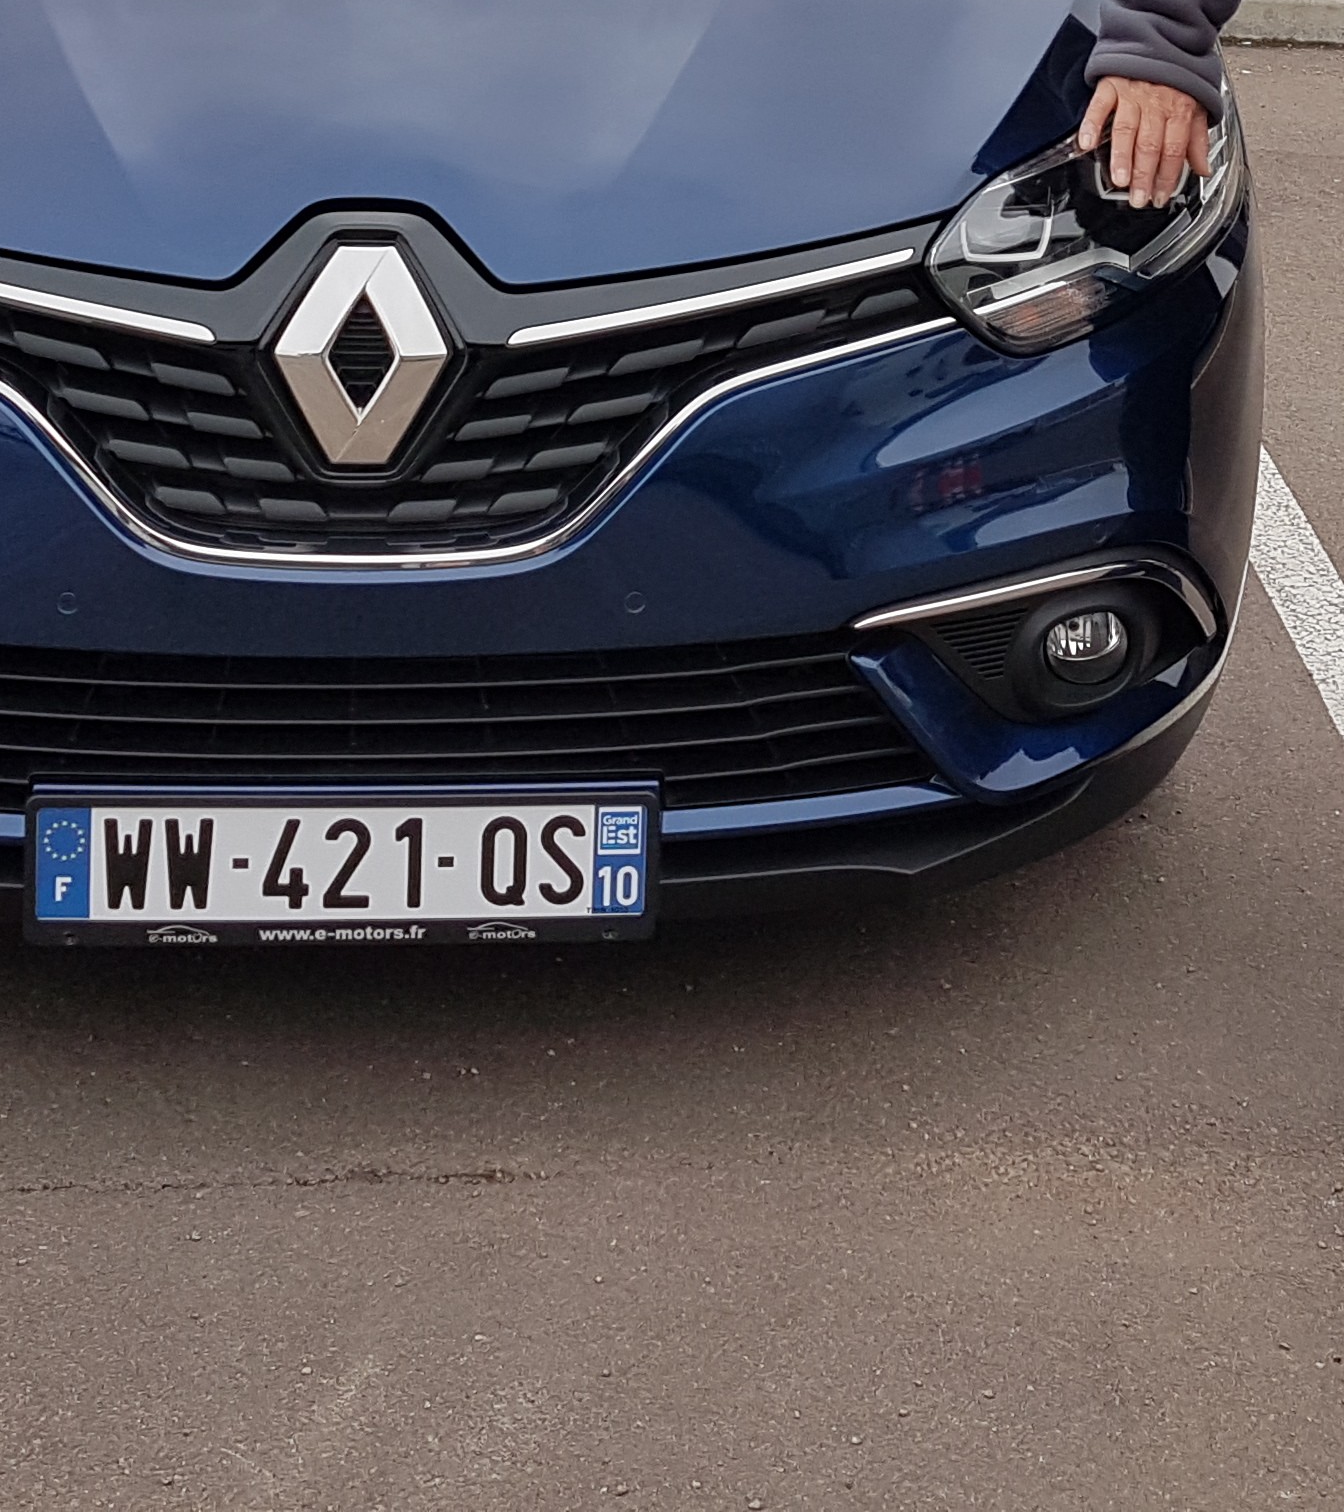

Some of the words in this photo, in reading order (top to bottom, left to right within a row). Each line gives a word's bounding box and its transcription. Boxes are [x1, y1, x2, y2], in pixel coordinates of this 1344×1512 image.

[602, 814, 638, 825] Grand
[602, 826, 637, 844] Est
[103, 815, 586, 909] WW-421-QS
[55, 876, 72, 902] F
[598, 865, 639, 907] 10
[259, 925, 427, 941] www.e-motors.fr
